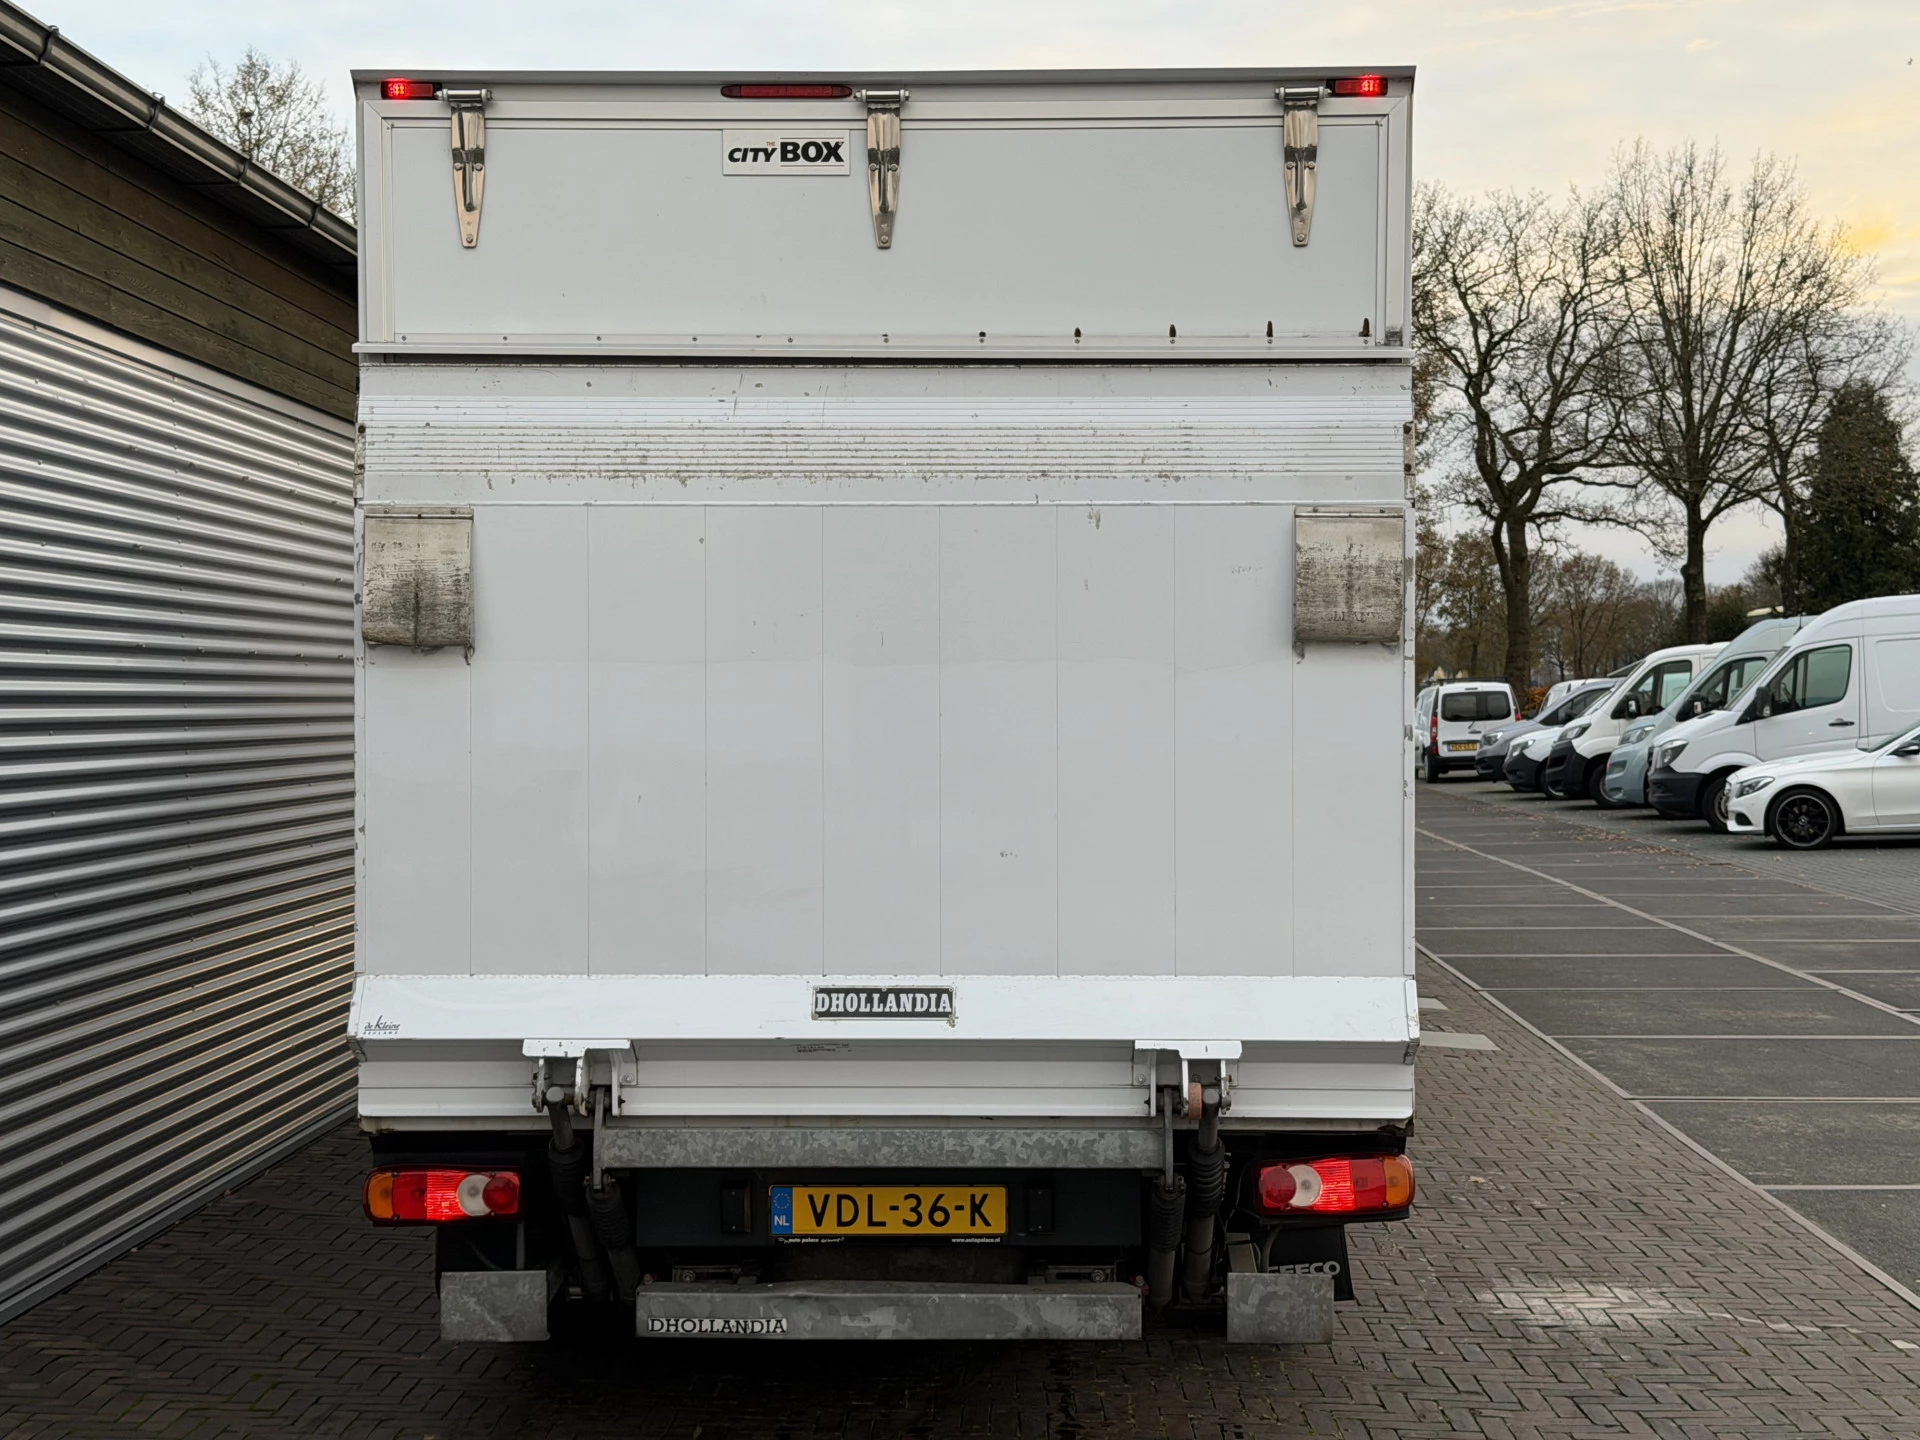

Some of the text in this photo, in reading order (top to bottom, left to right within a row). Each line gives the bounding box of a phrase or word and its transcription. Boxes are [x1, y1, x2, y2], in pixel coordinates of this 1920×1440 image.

[728, 141, 845, 163] CITY BOX
[815, 993, 952, 1012] DHOLLANDIA
[807, 1193, 992, 1228] VDL-36-K
[774, 1215, 790, 1226] NL
[650, 1318, 786, 1334] DHOLLANDIA
